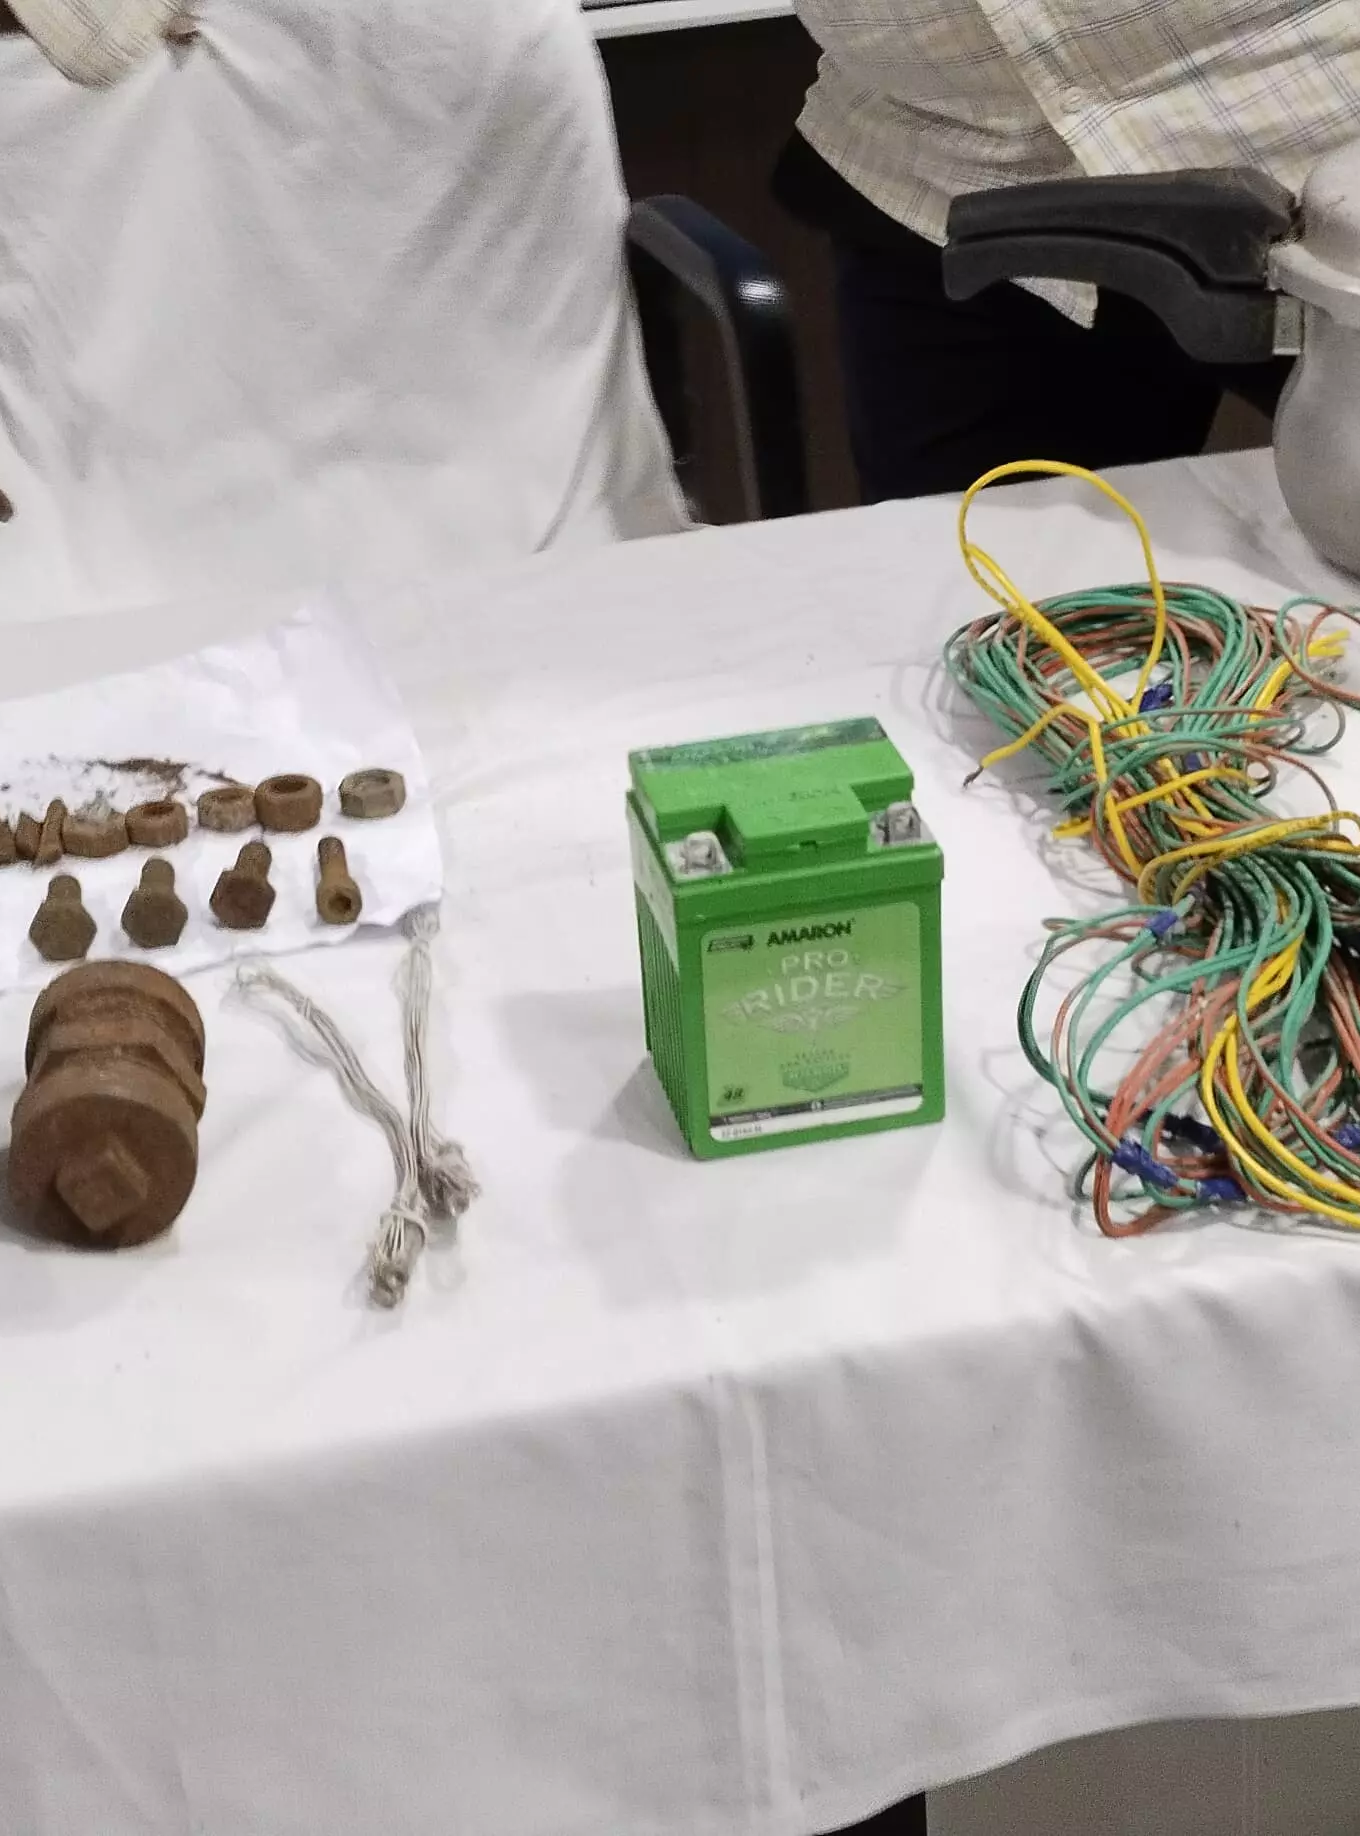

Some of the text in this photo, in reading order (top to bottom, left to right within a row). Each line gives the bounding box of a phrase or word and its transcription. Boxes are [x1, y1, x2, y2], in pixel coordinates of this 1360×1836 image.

[766, 921, 852, 947] AMARON
[781, 949, 849, 975] PRO
[743, 972, 886, 1014] RIDER
